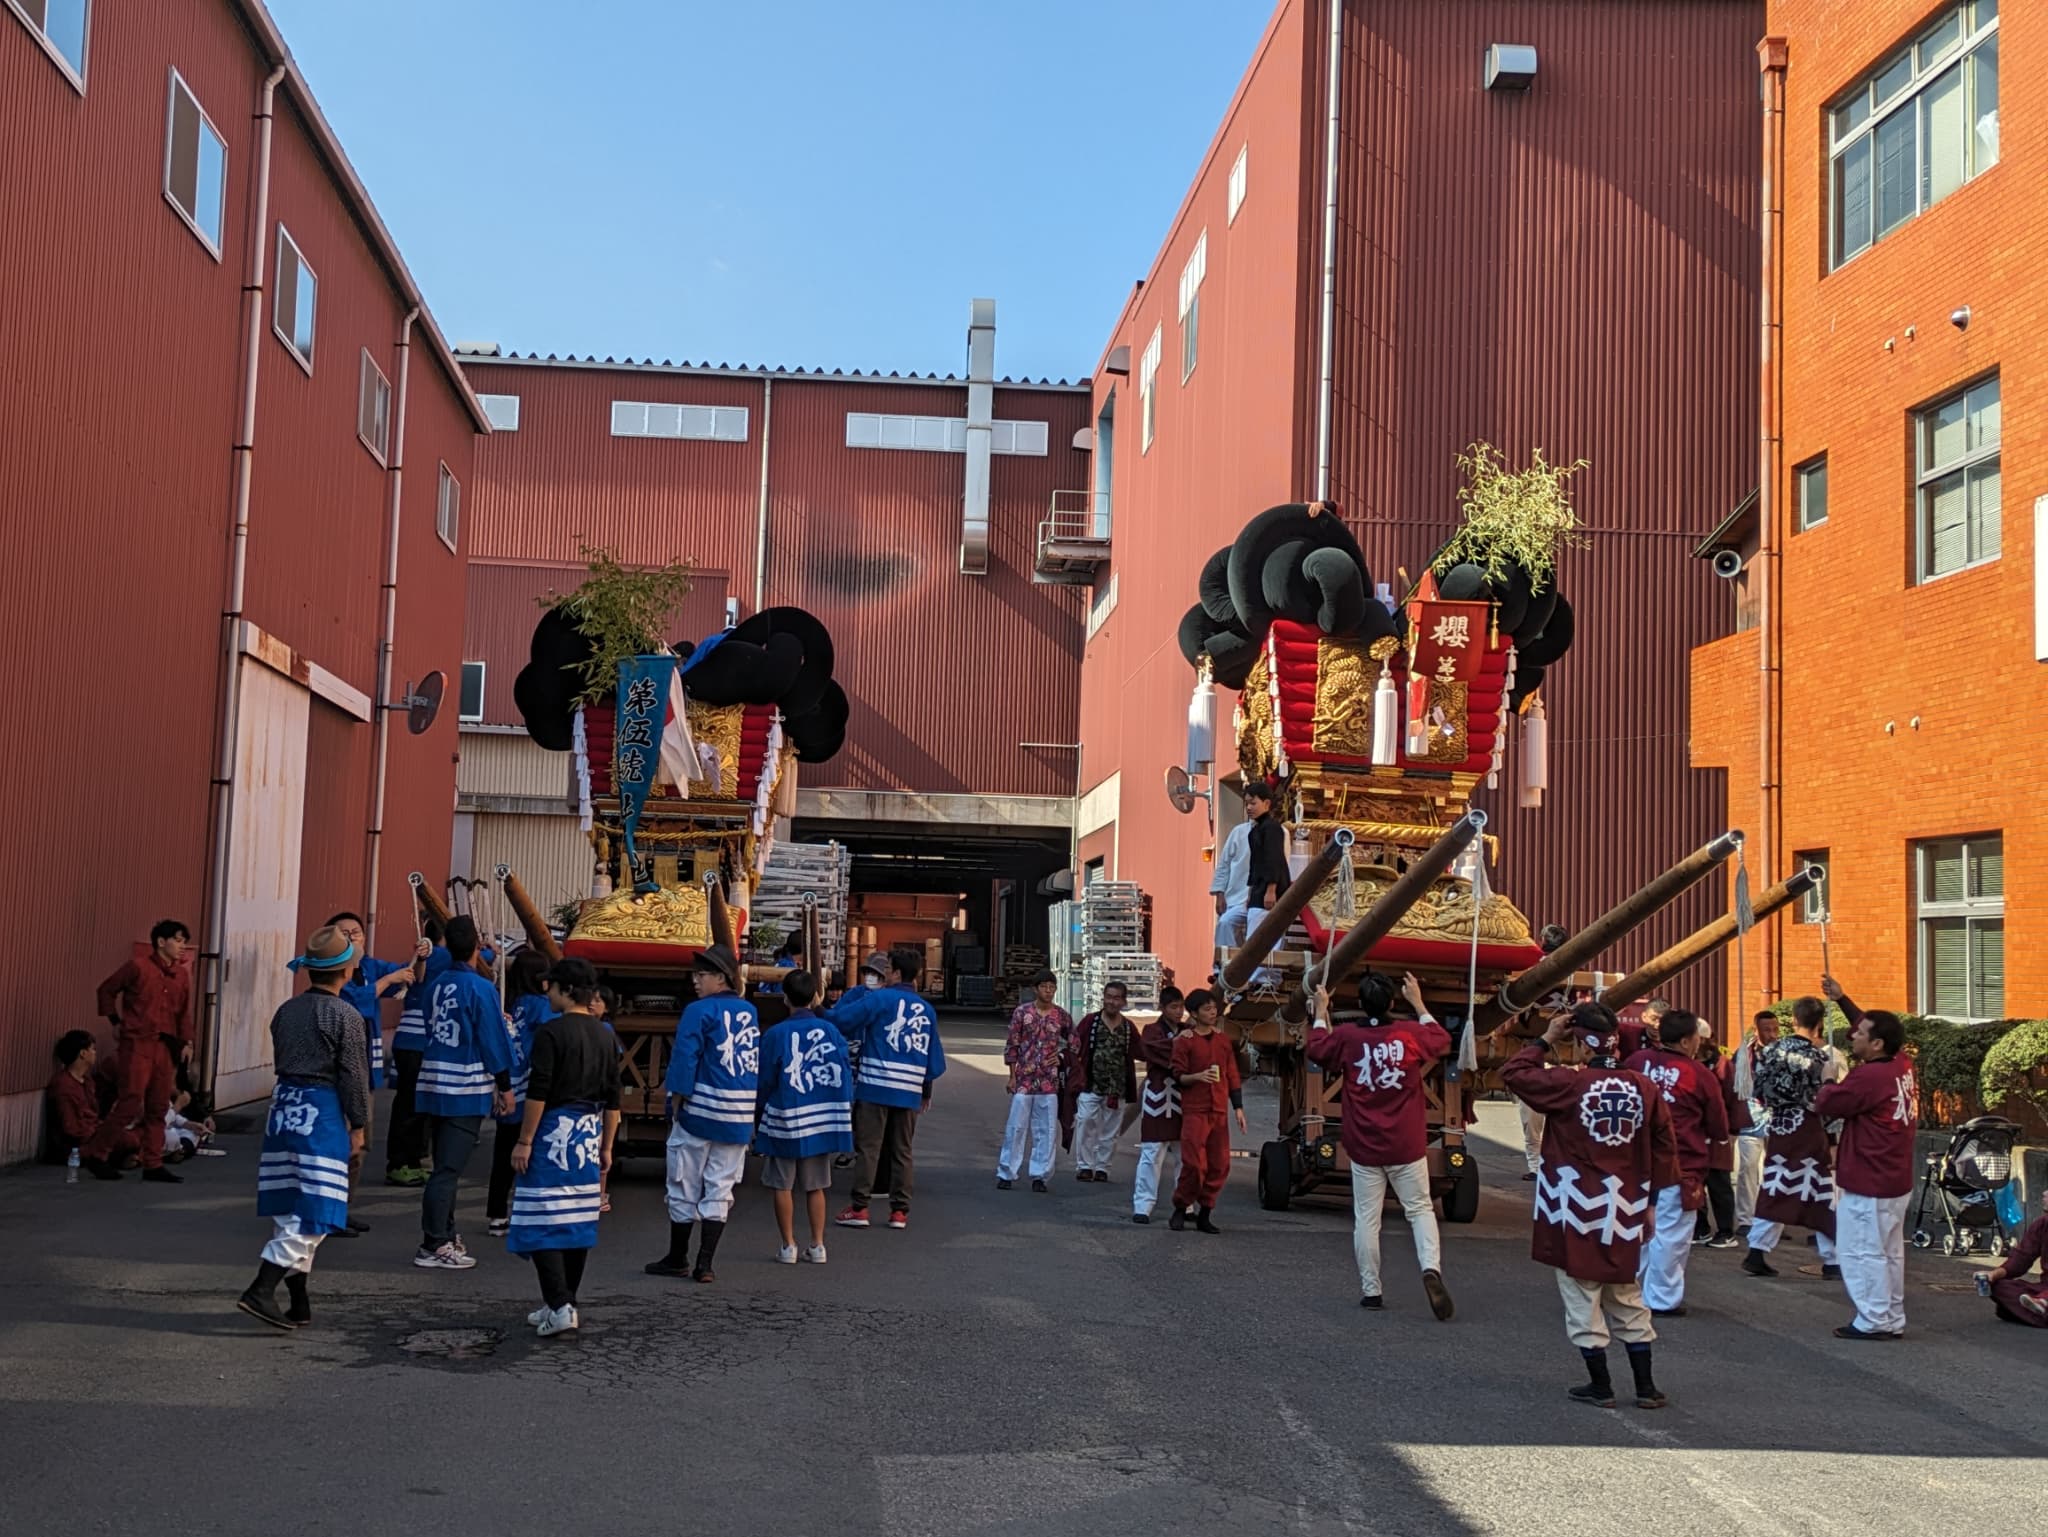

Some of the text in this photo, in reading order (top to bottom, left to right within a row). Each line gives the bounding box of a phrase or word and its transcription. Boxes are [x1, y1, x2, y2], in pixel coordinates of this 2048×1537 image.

[1429, 616, 1470, 648] 櫻
[1353, 1040, 1405, 1092] 櫻
[1593, 1092, 1635, 1135] 平
